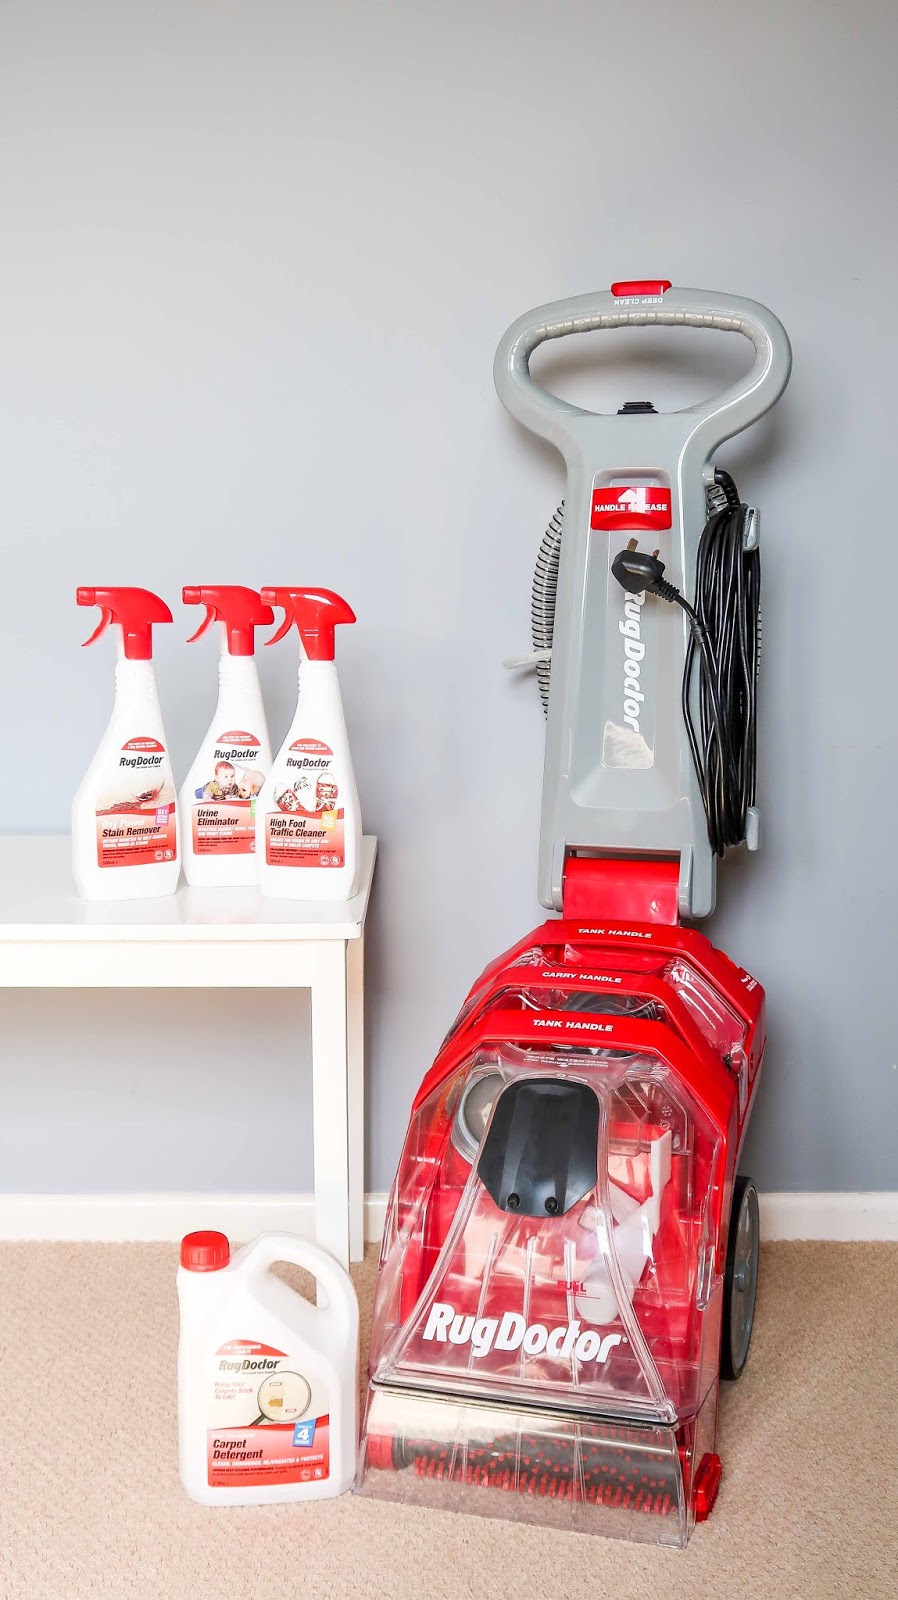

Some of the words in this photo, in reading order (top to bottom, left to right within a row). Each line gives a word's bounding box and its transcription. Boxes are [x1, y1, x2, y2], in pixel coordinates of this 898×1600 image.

[595, 504, 626, 512] HANDLE
[618, 590, 646, 733] RugDoctor
[214, 749, 259, 760] RugDoctor
[119, 756, 163, 768] RugDoctor
[286, 758, 332, 769] RugDoctor
[198, 809, 218, 817] Urine
[270, 818, 287, 828] High
[289, 819, 306, 827] Foot
[102, 829, 124, 837] Stain
[126, 826, 161, 836] Remover
[270, 828, 293, 837] Traffic
[295, 829, 326, 837] Cleaner
[608, 929, 652, 938] HANDLE
[542, 971, 577, 979] CARRY
[580, 973, 622, 983] HANDLE
[533, 1019, 562, 1027] TANK
[565, 1021, 613, 1032] HANDLE
[422, 1302, 622, 1363] RugDoctor
[219, 1359, 280, 1373] RugDoctor
[297, 1429, 310, 1440] 4
[213, 1439, 247, 1450] Carpet
[213, 1450, 263, 1461] Detergent
